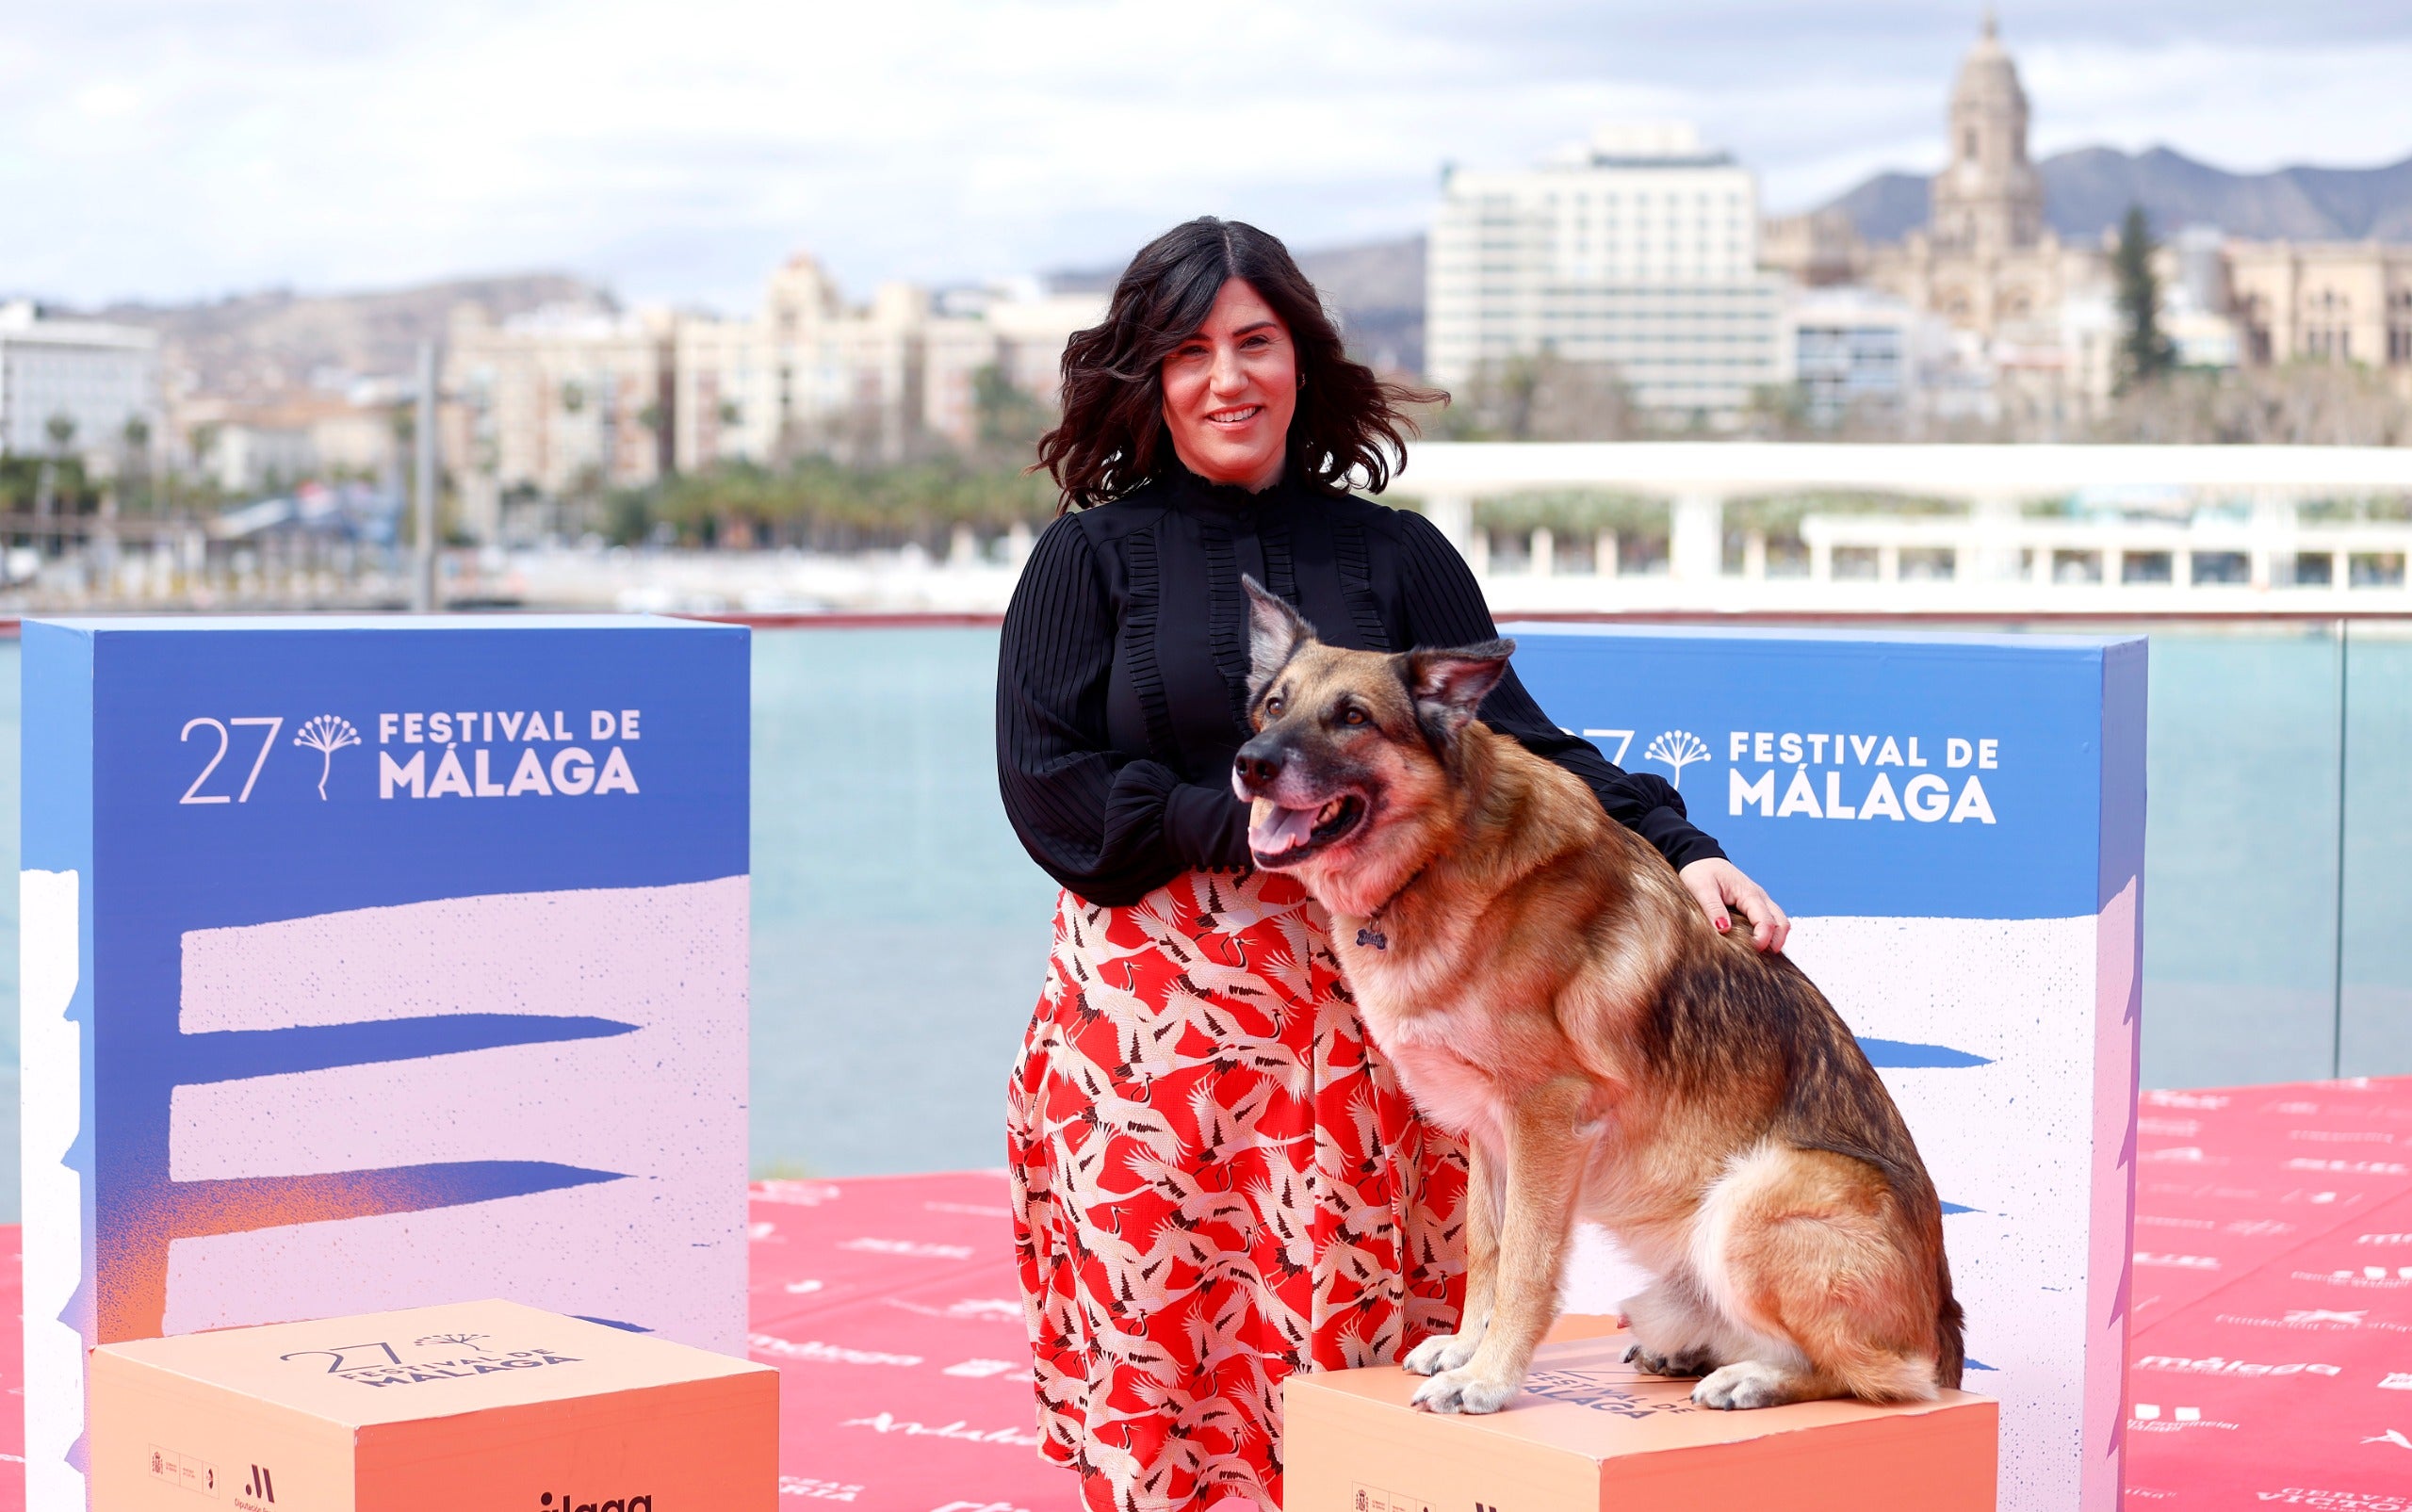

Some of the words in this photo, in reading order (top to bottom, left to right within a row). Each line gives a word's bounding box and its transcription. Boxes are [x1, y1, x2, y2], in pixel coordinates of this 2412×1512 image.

[380, 711, 573, 743] FESTIVAL
[592, 710, 640, 740] DE
[180, 717, 283, 804] 27
[1557, 726, 1636, 768] 7
[1729, 731, 1928, 767] FESTIVAL
[1947, 738, 1998, 769] DE
[380, 742, 640, 799] MÁLAGA
[1729, 763, 1997, 824] MÁLAGA
[280, 1342, 402, 1374] 27
[338, 1356, 501, 1381] FESTIVAL
[506, 1348, 556, 1358] DE
[1523, 1380, 1657, 1419] ÁLAGA
